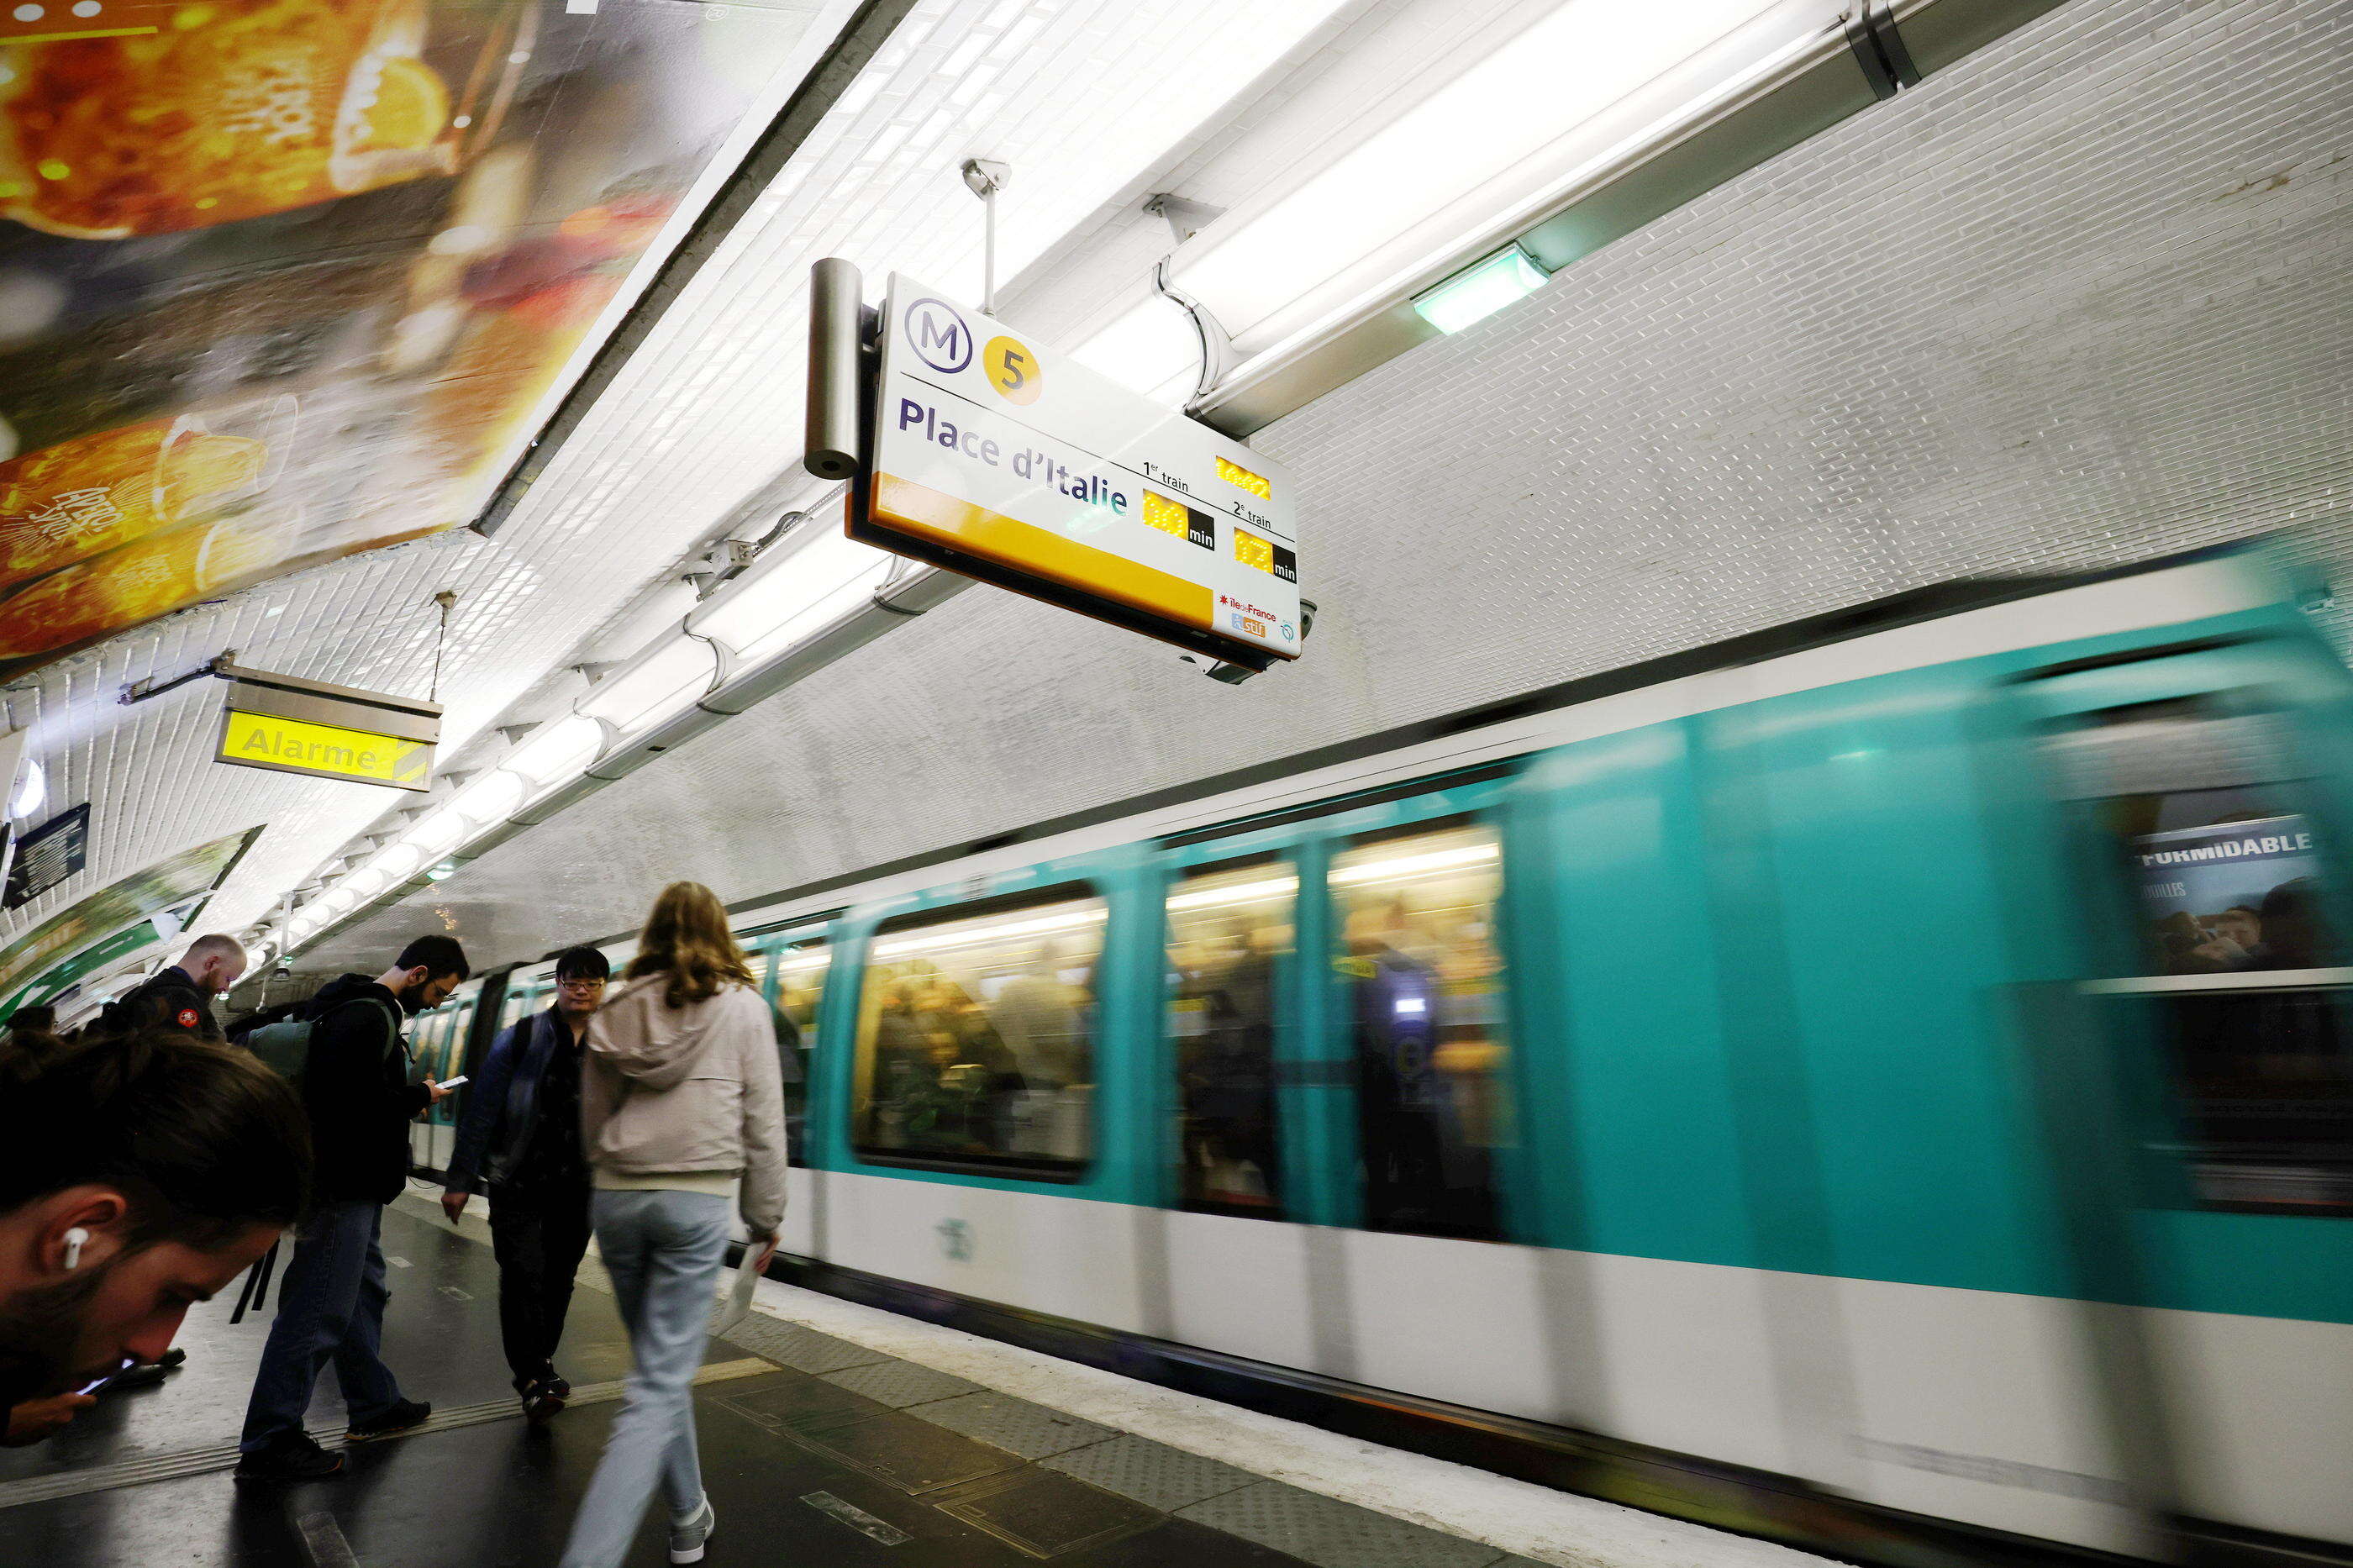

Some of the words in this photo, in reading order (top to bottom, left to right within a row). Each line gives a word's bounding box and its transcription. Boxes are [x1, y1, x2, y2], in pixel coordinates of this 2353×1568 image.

[921, 310, 957, 361] M
[1001, 349, 1024, 390] 5
[899, 397, 1000, 466] Place
[1161, 472, 1189, 492] train
[1248, 512, 1271, 529] train
[1189, 529, 1213, 548] min
[1275, 563, 1296, 581] min
[1248, 603, 1277, 622] France
[242, 729, 376, 769] Alarme
